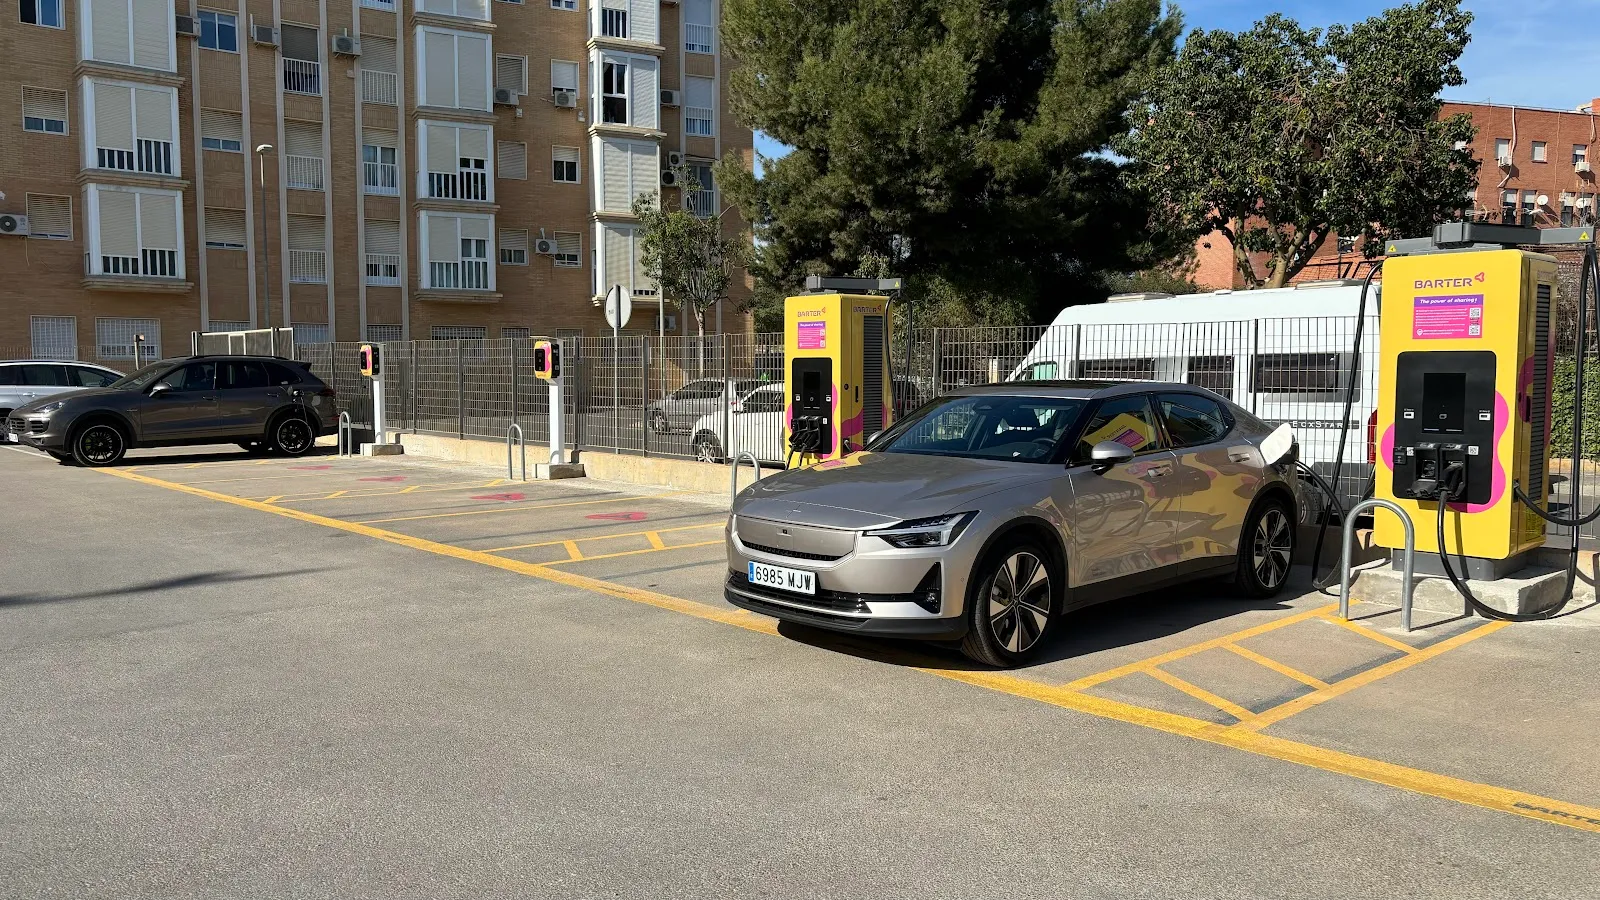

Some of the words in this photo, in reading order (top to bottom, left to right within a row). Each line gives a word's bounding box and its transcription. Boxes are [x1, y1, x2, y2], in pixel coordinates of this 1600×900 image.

[1414, 278, 1472, 289] BARTER
[756, 566, 783, 585] 6985
[788, 571, 811, 590] MJW
